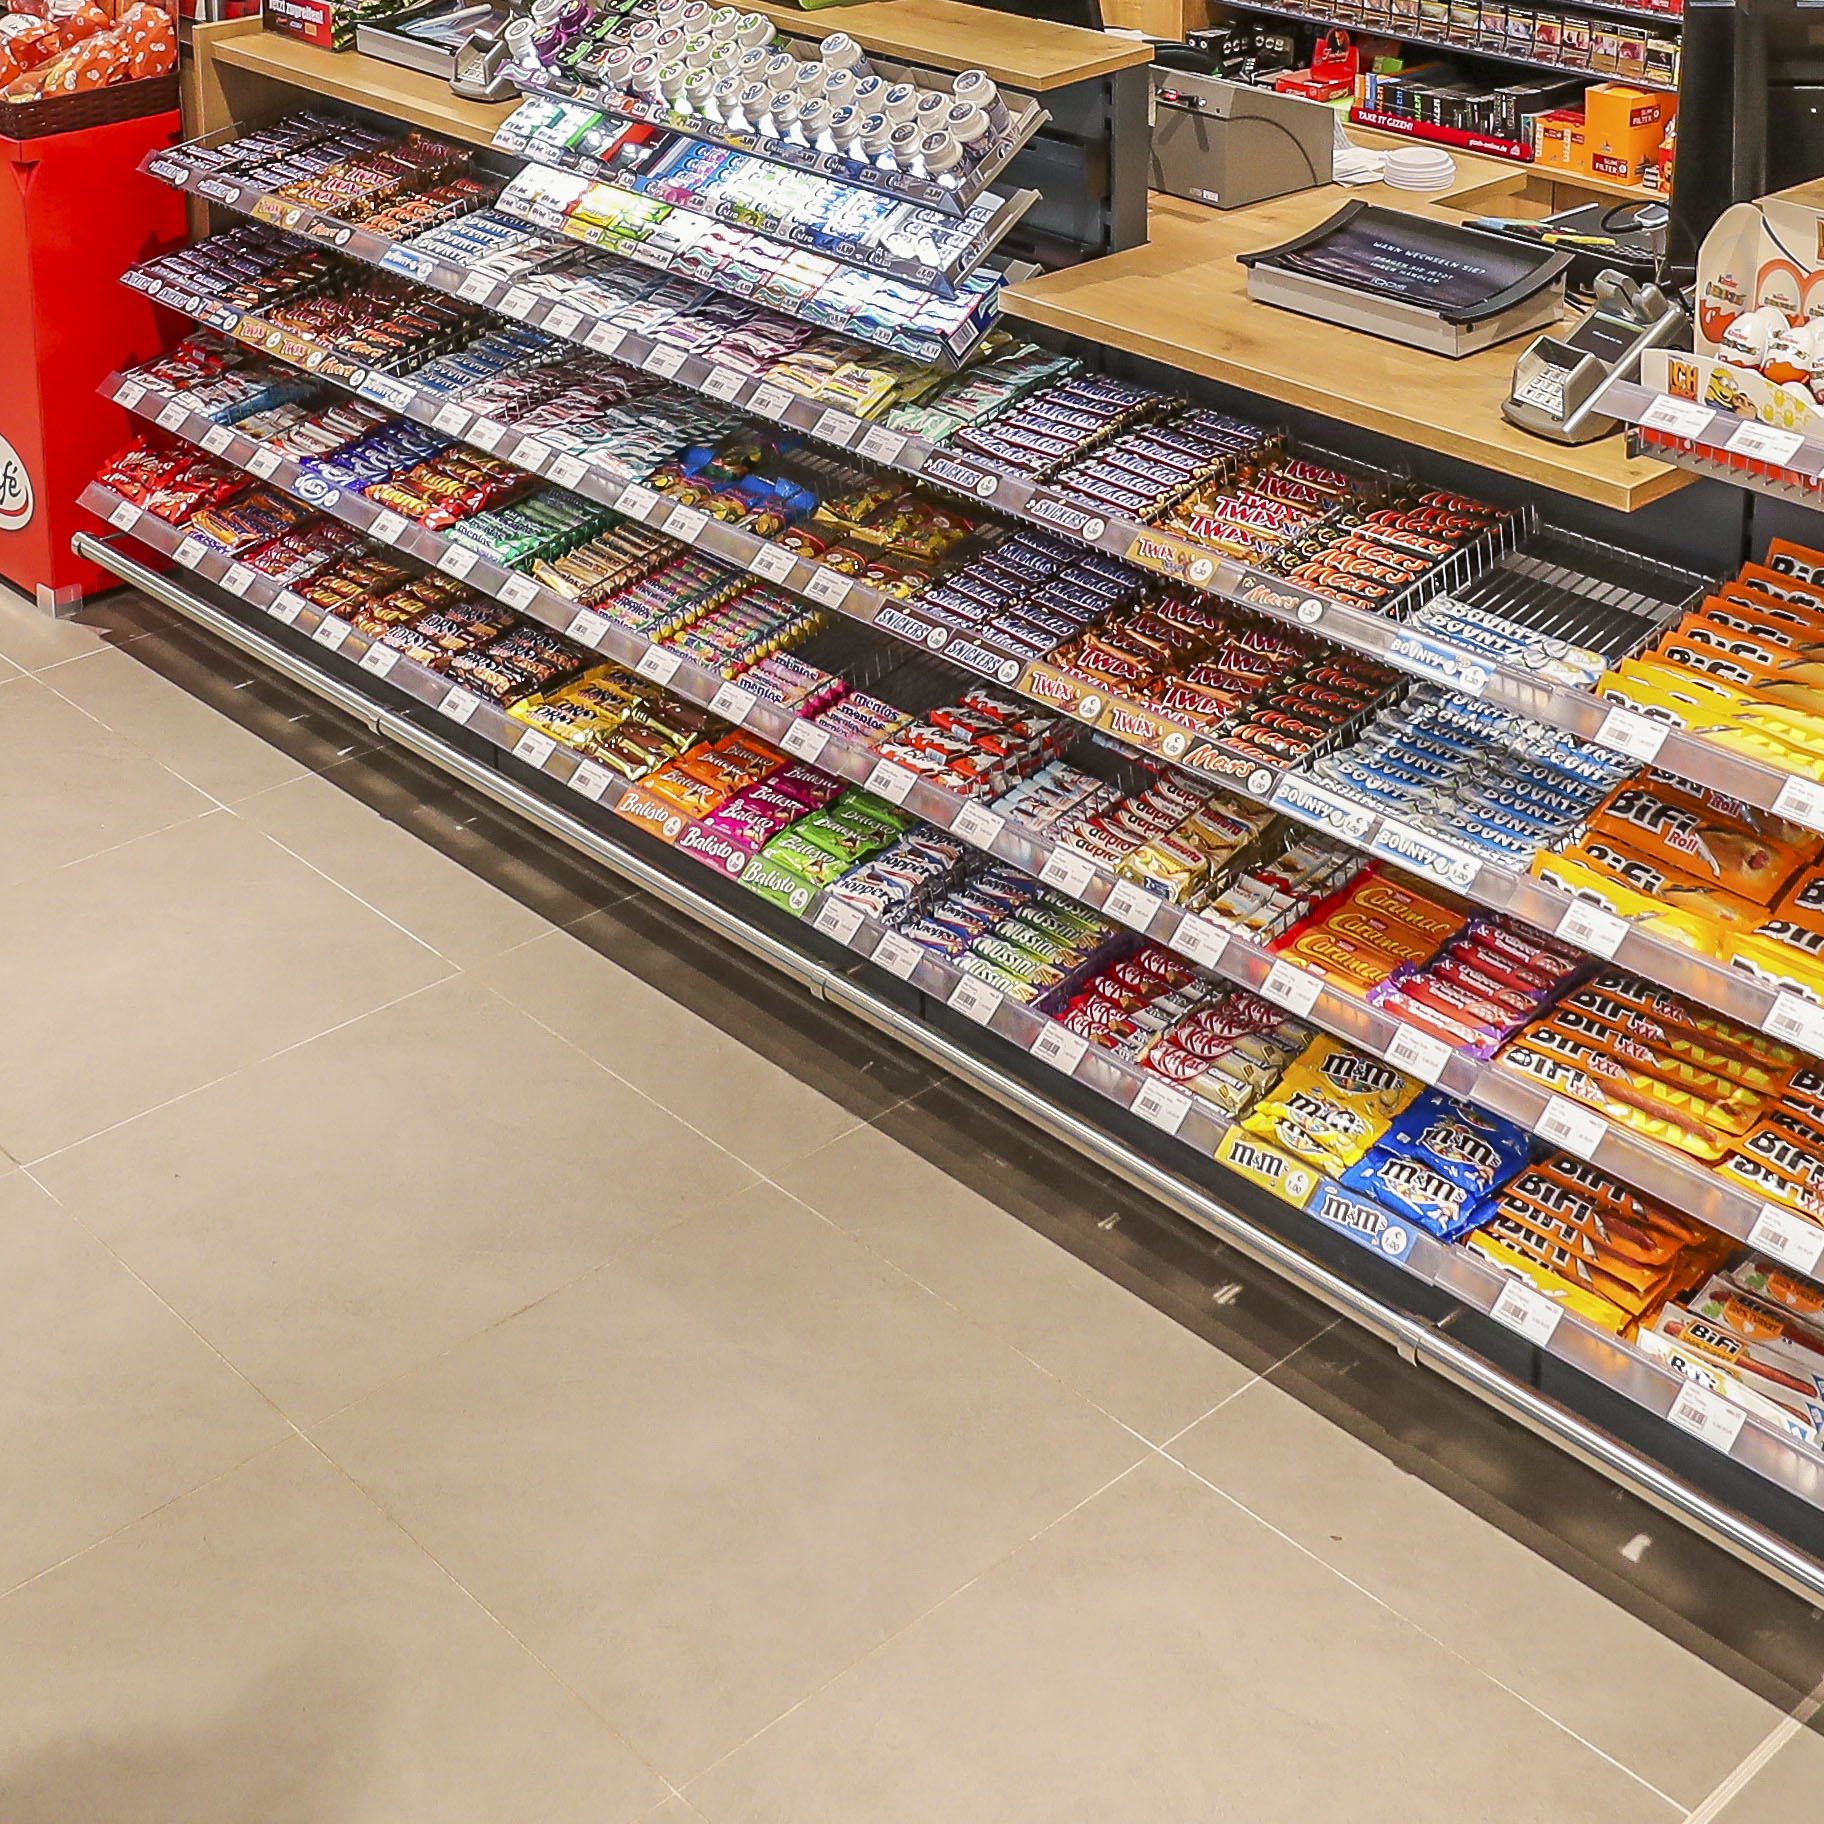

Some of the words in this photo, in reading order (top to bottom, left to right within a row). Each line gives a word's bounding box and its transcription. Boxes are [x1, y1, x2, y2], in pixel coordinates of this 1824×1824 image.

[1595, 162, 1617, 174] FILTER
[930, 456, 980, 491] SNICKERS
[1030, 499, 1087, 532] SNICKERS
[1136, 536, 1175, 560] Twix
[1245, 578, 1299, 610] Mars
[878, 607, 928, 641] SNICKERS
[1391, 637, 1443, 672] BOUNTY
[1028, 670, 1071, 701] Twix
[1108, 707, 1151, 737] Twix
[1184, 745, 1255, 778] Mars
[619, 792, 669, 822] Balisto
[1278, 783, 1329, 817] BOUNTY
[1606, 790, 1700, 836] BiFi
[680, 825, 732, 858] Balisto
[1382, 828, 1437, 863] BOUNTY
[1665, 830, 1698, 852] Roll
[744, 861, 796, 893] Balisto
